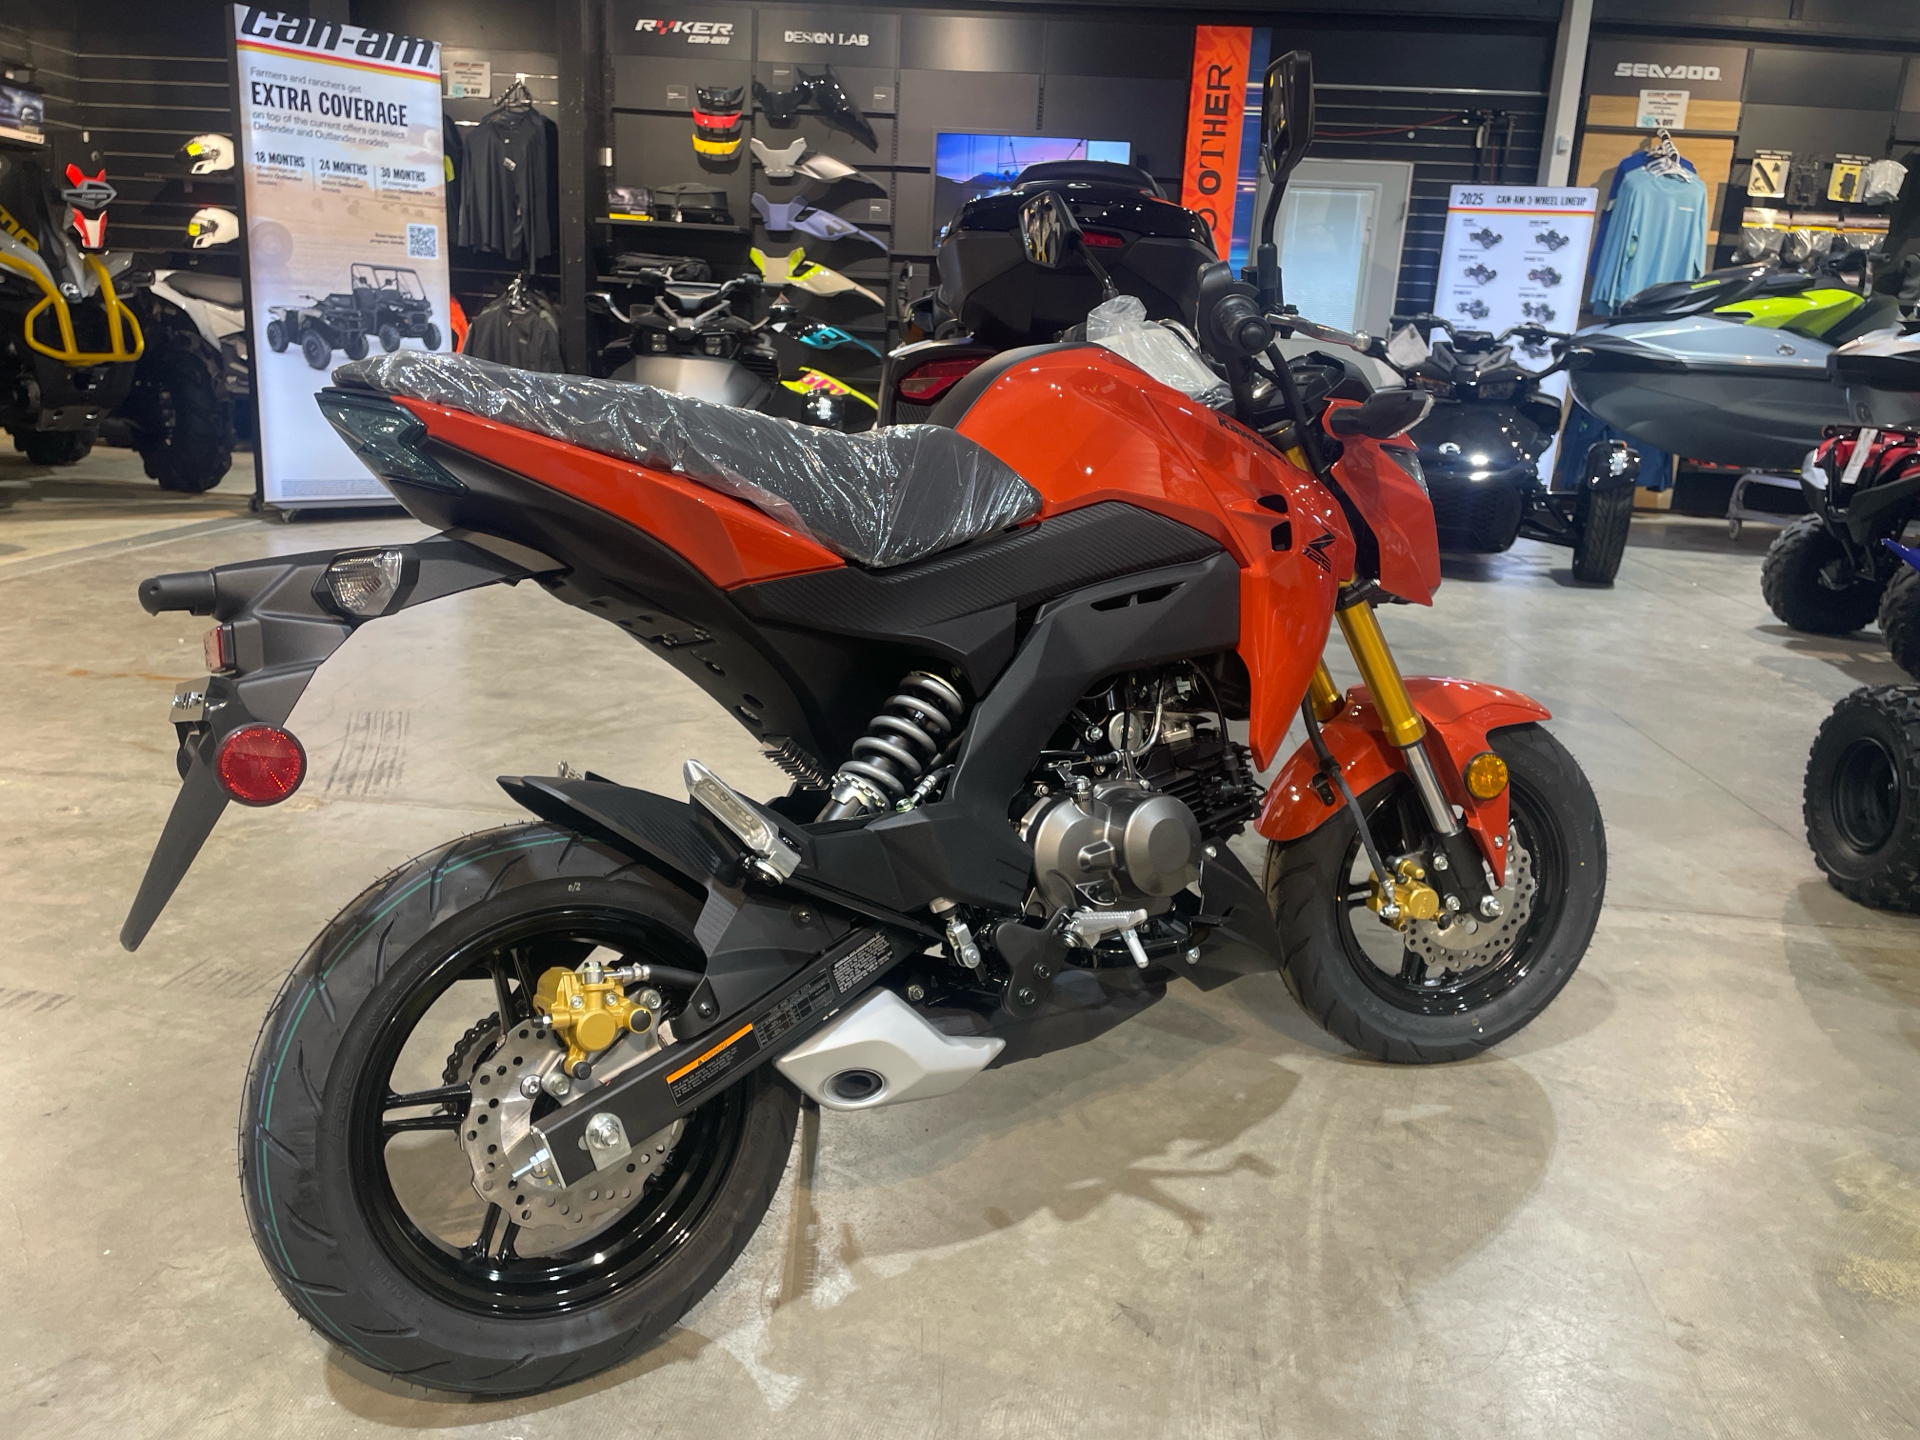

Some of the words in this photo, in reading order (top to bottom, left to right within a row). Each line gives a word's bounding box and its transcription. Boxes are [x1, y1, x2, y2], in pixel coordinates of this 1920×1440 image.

[635, 18, 732, 36] RYKER
[784, 30, 834, 45] DESIGN
[838, 32, 869, 46] LAB
[250, 66, 288, 81] Farmers
[289, 74, 306, 85] and
[308, 77, 346, 91] ranchers
[347, 84, 362, 94] get
[251, 81, 312, 113] EXTRA
[318, 91, 409, 127] COVERAGE
[252, 110, 265, 120] on
[266, 111, 281, 123] top
[282, 114, 292, 123] of
[293, 115, 308, 126] the
[309, 119, 342, 132] current
[343, 123, 367, 135] offers
[368, 128, 380, 137] on
[381, 130, 406, 140] select
[1197, 64, 1233, 196] OTHER
[252, 121, 296, 135] Defender
[296, 128, 314, 138] and
[314, 130, 357, 145] Outlander
[358, 138, 390, 149] models
[268, 152, 306, 169] MONTHS
[332, 161, 369, 177] MONTHS
[392, 168, 427, 183] MONTHS
[1459, 192, 1485, 205] 2025
[701, 1042, 728, 1062] WARNING
